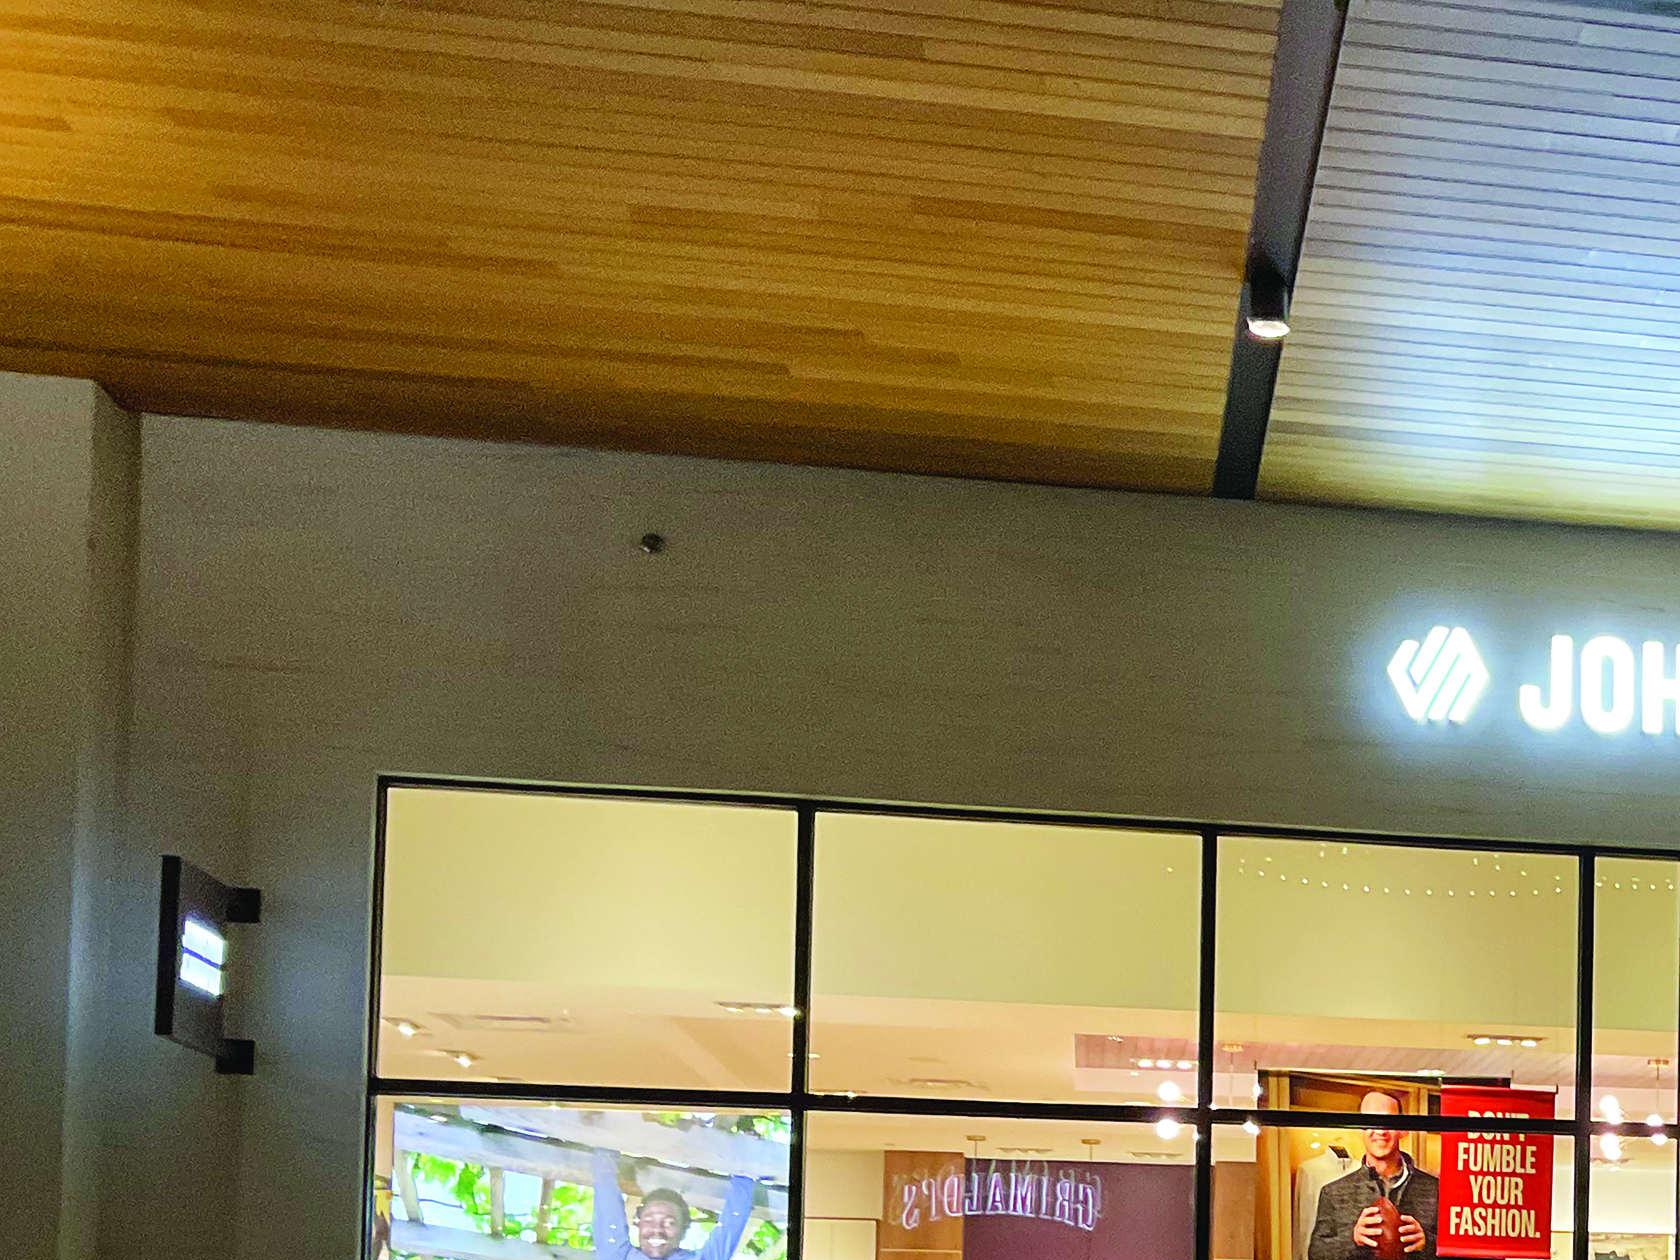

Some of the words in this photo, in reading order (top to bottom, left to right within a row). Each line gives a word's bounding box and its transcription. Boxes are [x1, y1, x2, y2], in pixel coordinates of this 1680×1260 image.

[1457, 1142, 1538, 1174] FUMBLE
[1469, 1174, 1524, 1206] YOUR
[1449, 1205, 1542, 1239] FASHION.
